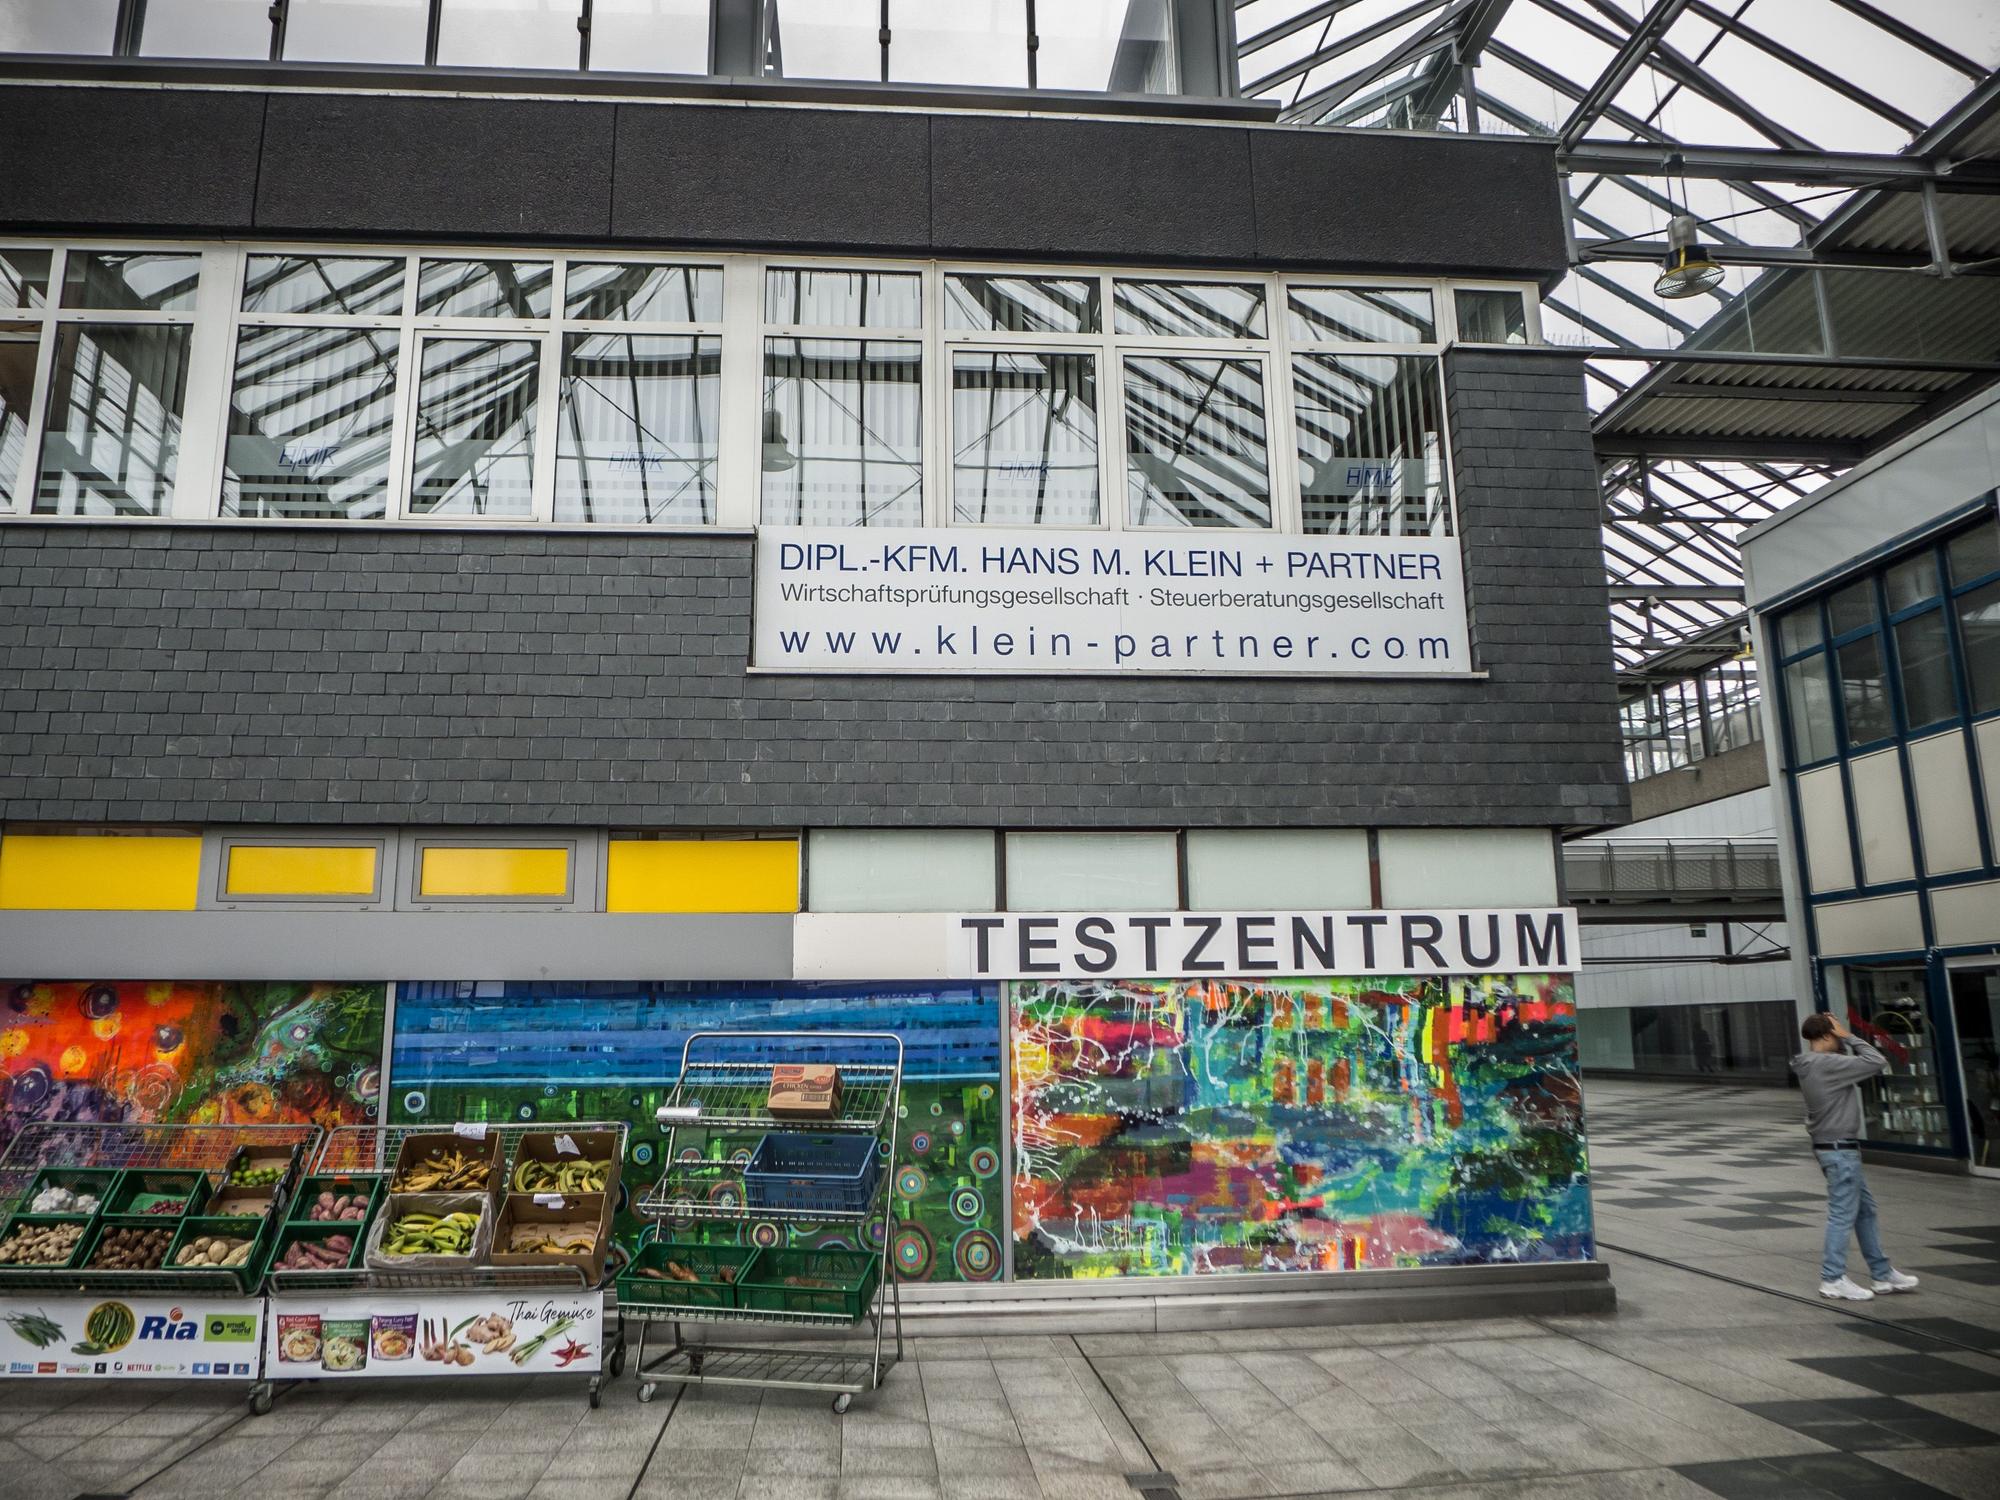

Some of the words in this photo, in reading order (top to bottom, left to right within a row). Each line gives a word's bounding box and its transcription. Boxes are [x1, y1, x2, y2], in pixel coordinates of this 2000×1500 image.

[780, 543, 968, 574] DIPL.-KFM.
[983, 546, 1080, 576] HANS
[1093, 548, 1132, 577] M.
[1144, 549, 1242, 578] KLEIN
[1255, 555, 1274, 575] +
[1288, 551, 1442, 581] PARTNER
[780, 583, 1130, 609] Wirtschaftsprüfungsgesellschaft
[1150, 587, 1445, 613] Steuerberatungsgesellschaft
[779, 625, 1450, 666] www.klein-partner.com
[961, 912, 1569, 974] TESTZENTRUM
[138, 1306, 198, 1341] Ria
[507, 1300, 539, 1324] Thai
[540, 1300, 596, 1324] Gemüse
[127, 1362, 152, 1372] NETFLIX
